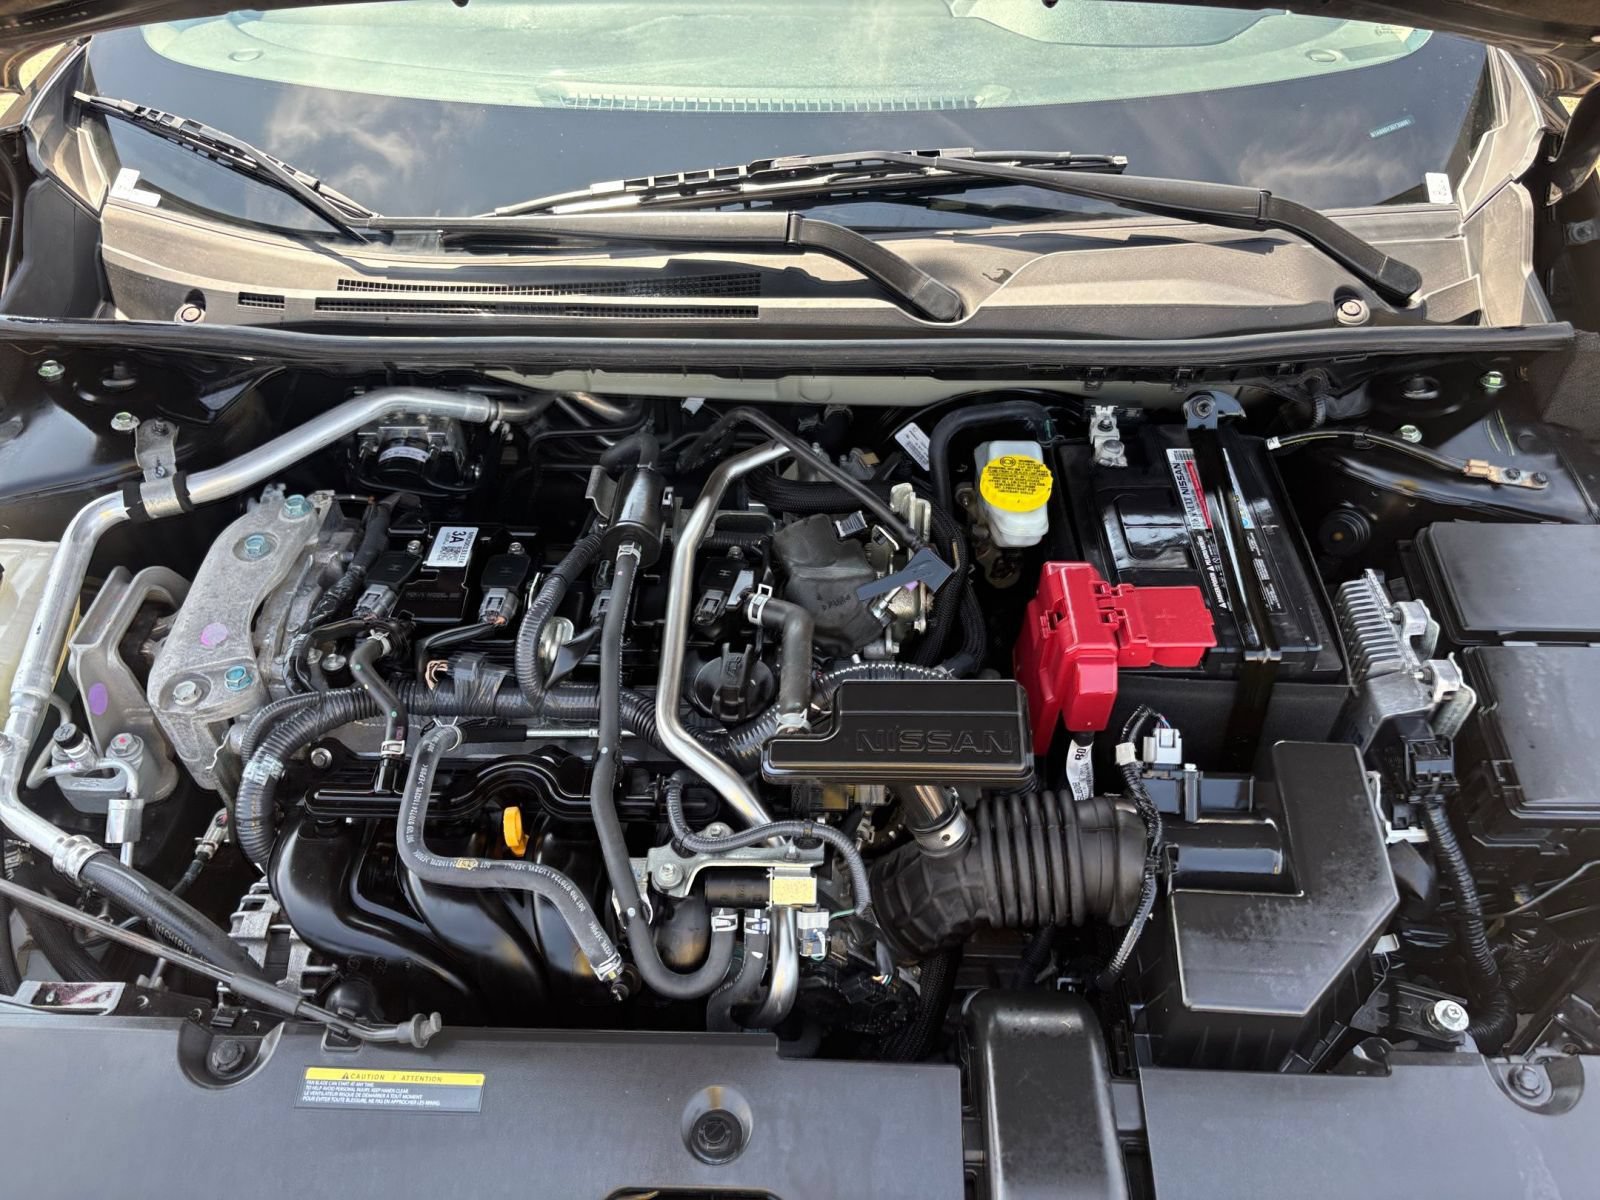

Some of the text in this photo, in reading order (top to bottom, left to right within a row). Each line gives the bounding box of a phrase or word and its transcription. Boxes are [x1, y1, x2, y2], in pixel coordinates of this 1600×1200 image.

[1173, 462, 1190, 496] NISSAN
[450, 531, 466, 544] 3A
[856, 727, 1013, 754] NISSAN
[401, 1074, 442, 1082] ATTENTION
